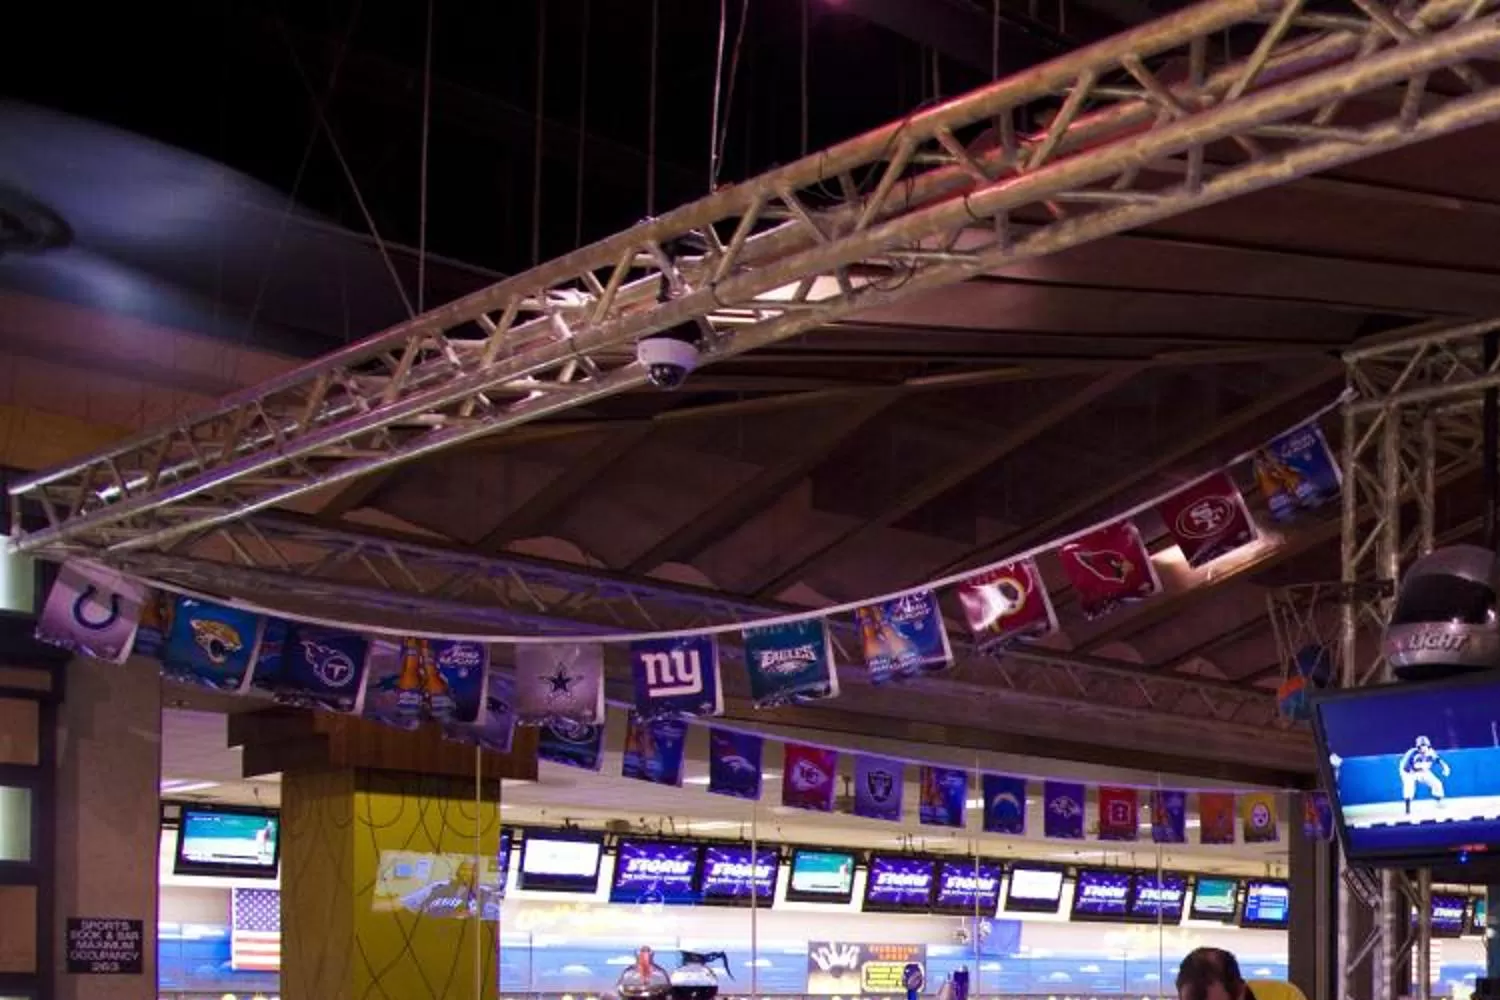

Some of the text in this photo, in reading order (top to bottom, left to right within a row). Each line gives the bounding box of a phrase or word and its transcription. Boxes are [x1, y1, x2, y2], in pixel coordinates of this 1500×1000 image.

[1408, 633, 1468, 651] LIGHT
[641, 650, 703, 697] ny
[81, 920, 130, 931] SPORTS
